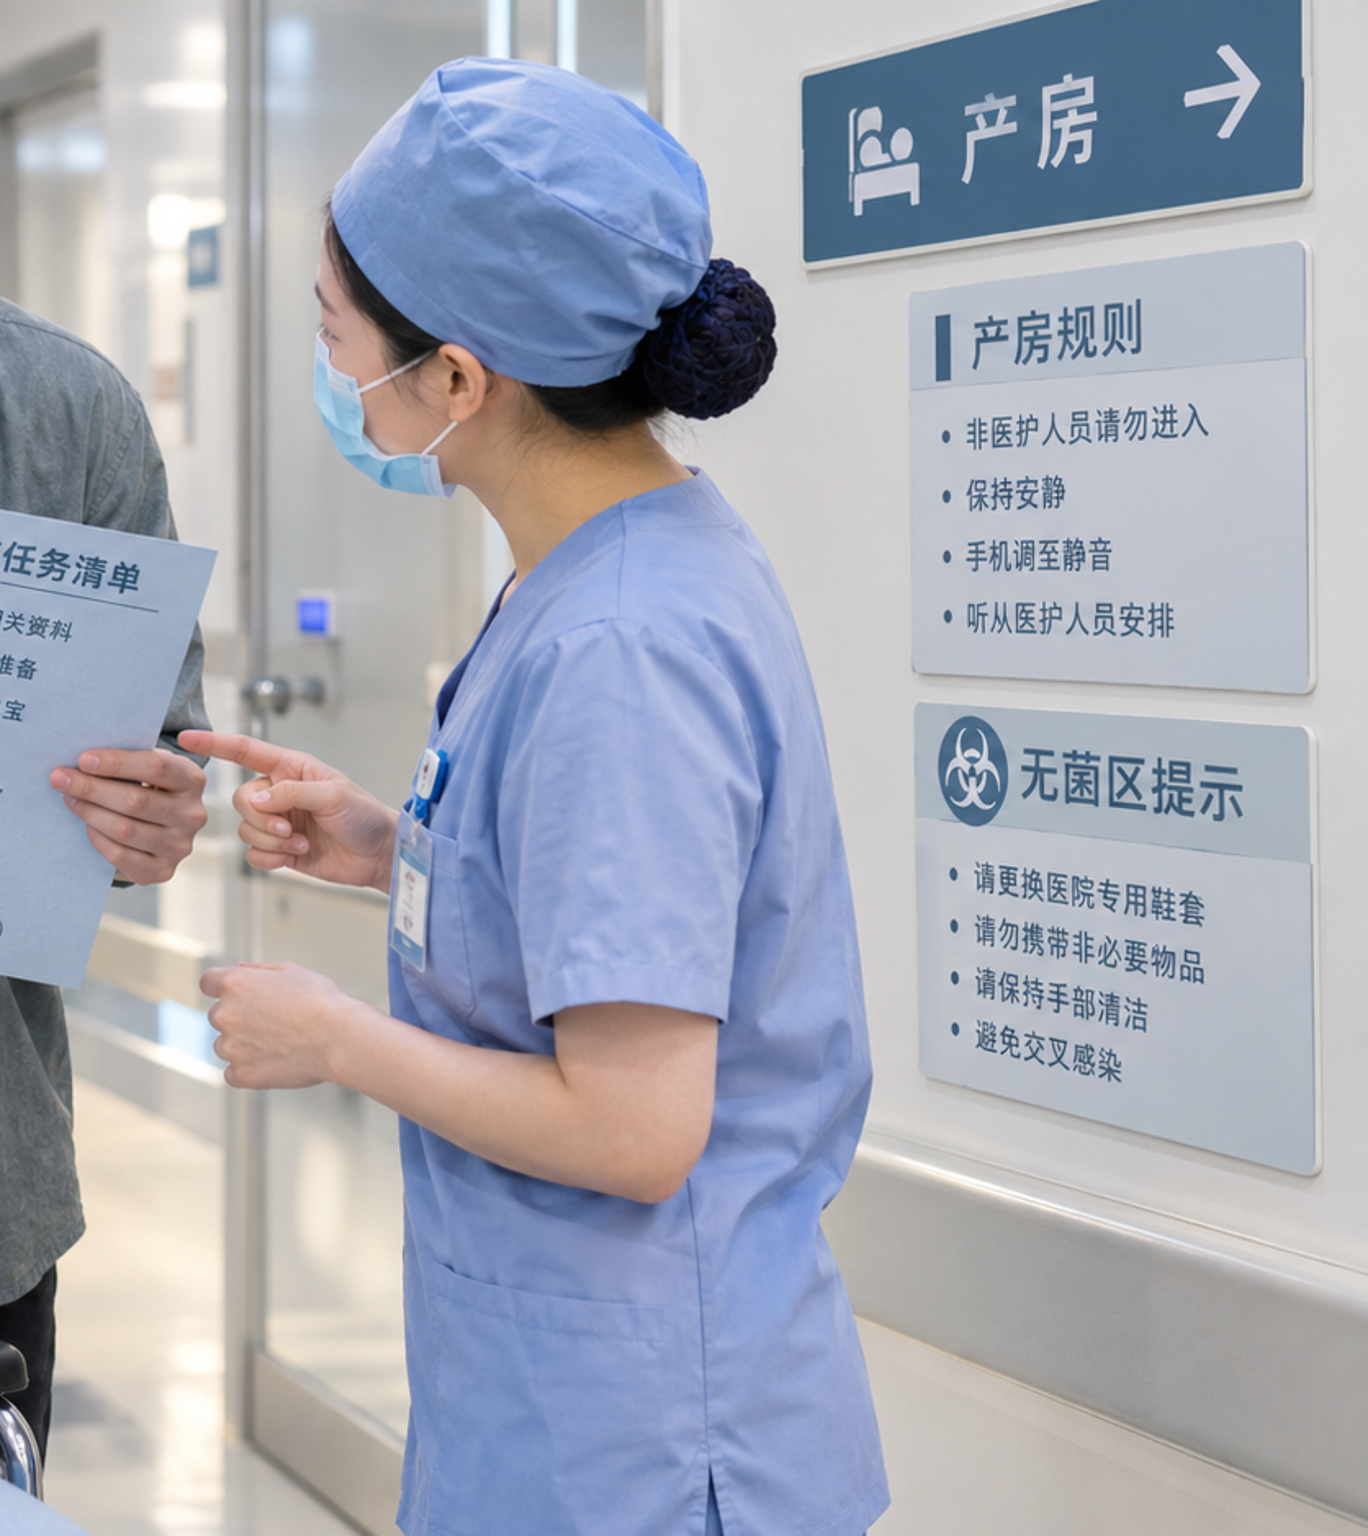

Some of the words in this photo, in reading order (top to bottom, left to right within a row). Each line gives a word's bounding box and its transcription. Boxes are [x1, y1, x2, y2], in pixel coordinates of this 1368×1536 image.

[961, 73, 1098, 185] 产房
[971, 298, 1142, 371] 产房规则
[966, 402, 1209, 451] 非医护人员请勿进入
[966, 474, 1066, 512] 保持安静
[965, 536, 1113, 573] 手机调至静音
[967, 601, 1175, 639] 听从医护人员安排
[1020, 747, 1244, 822] 无菌区提示
[973, 861, 1205, 928] 请更换医院专用鞋套
[974, 914, 1205, 985] 请勿携带非必要物品
[974, 966, 1148, 1033] 请保持手部清洁
[975, 1019, 1122, 1083] 避免交叉感染
